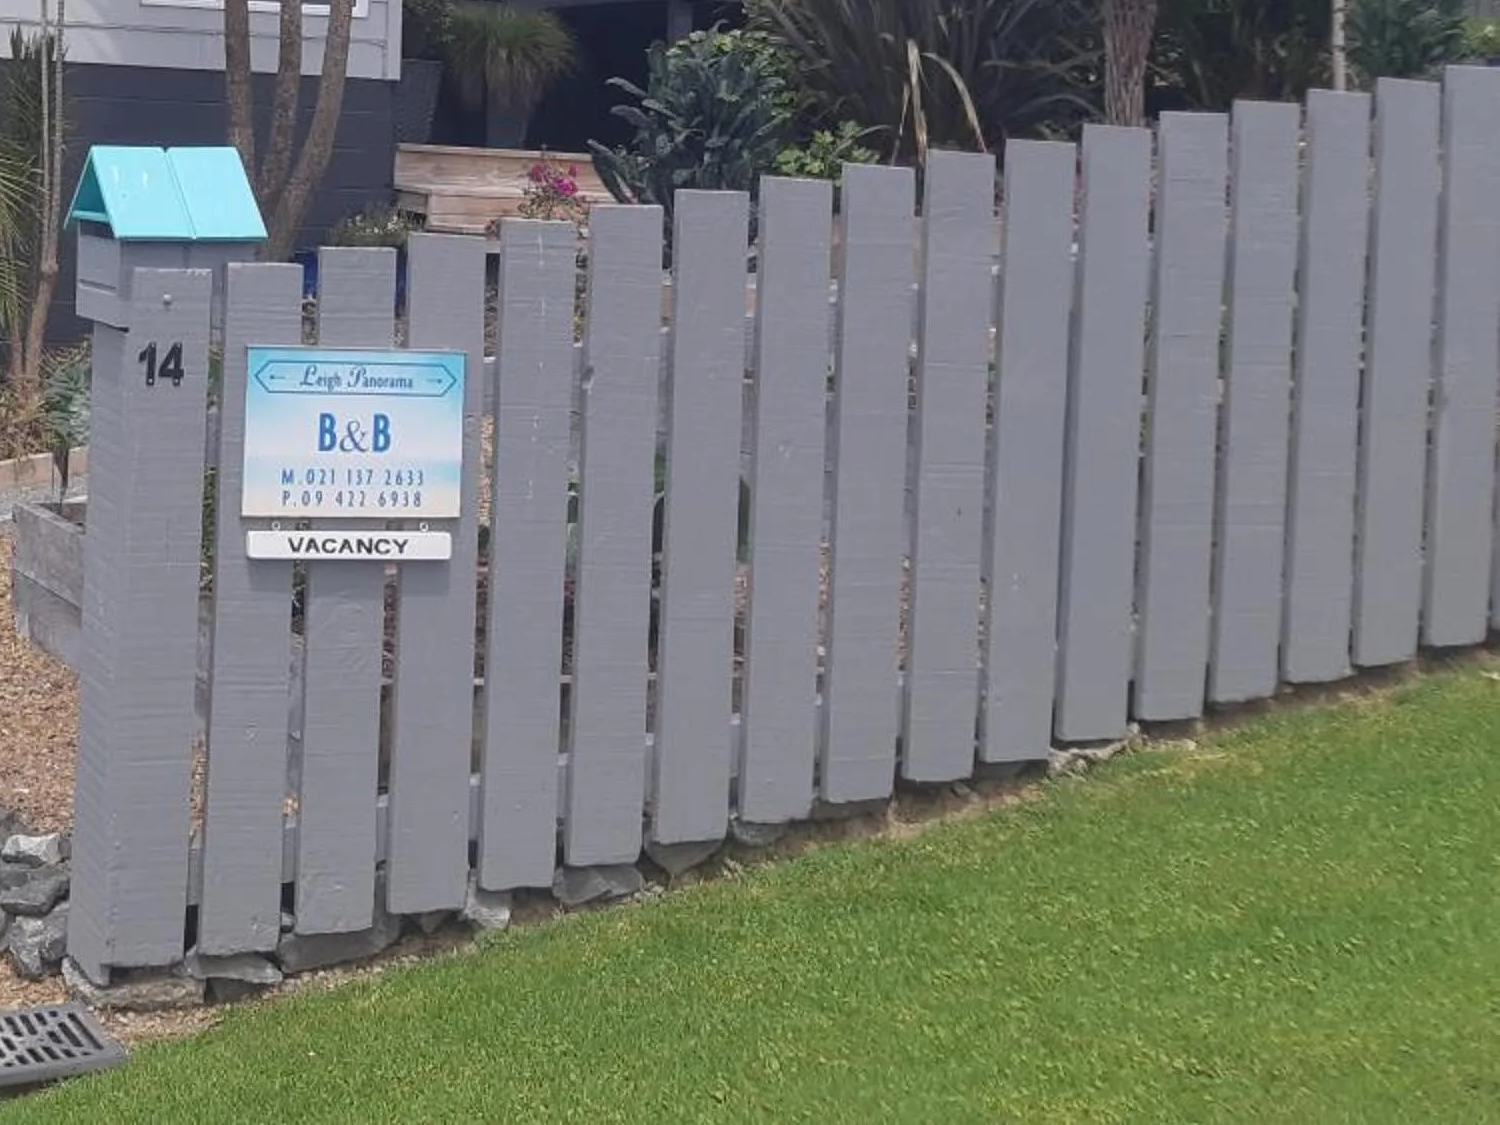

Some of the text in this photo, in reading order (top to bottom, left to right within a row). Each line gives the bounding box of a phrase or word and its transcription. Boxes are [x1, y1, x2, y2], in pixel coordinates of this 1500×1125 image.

[138, 342, 184, 387] 14
[300, 364, 414, 393] Leigh Panorama
[317, 412, 391, 453] B&B
[347, 468, 373, 486] 137
[384, 468, 424, 487] 2633
[335, 490, 366, 508] 422
[378, 490, 422, 508] 6938
[287, 537, 409, 555] VACANCY
